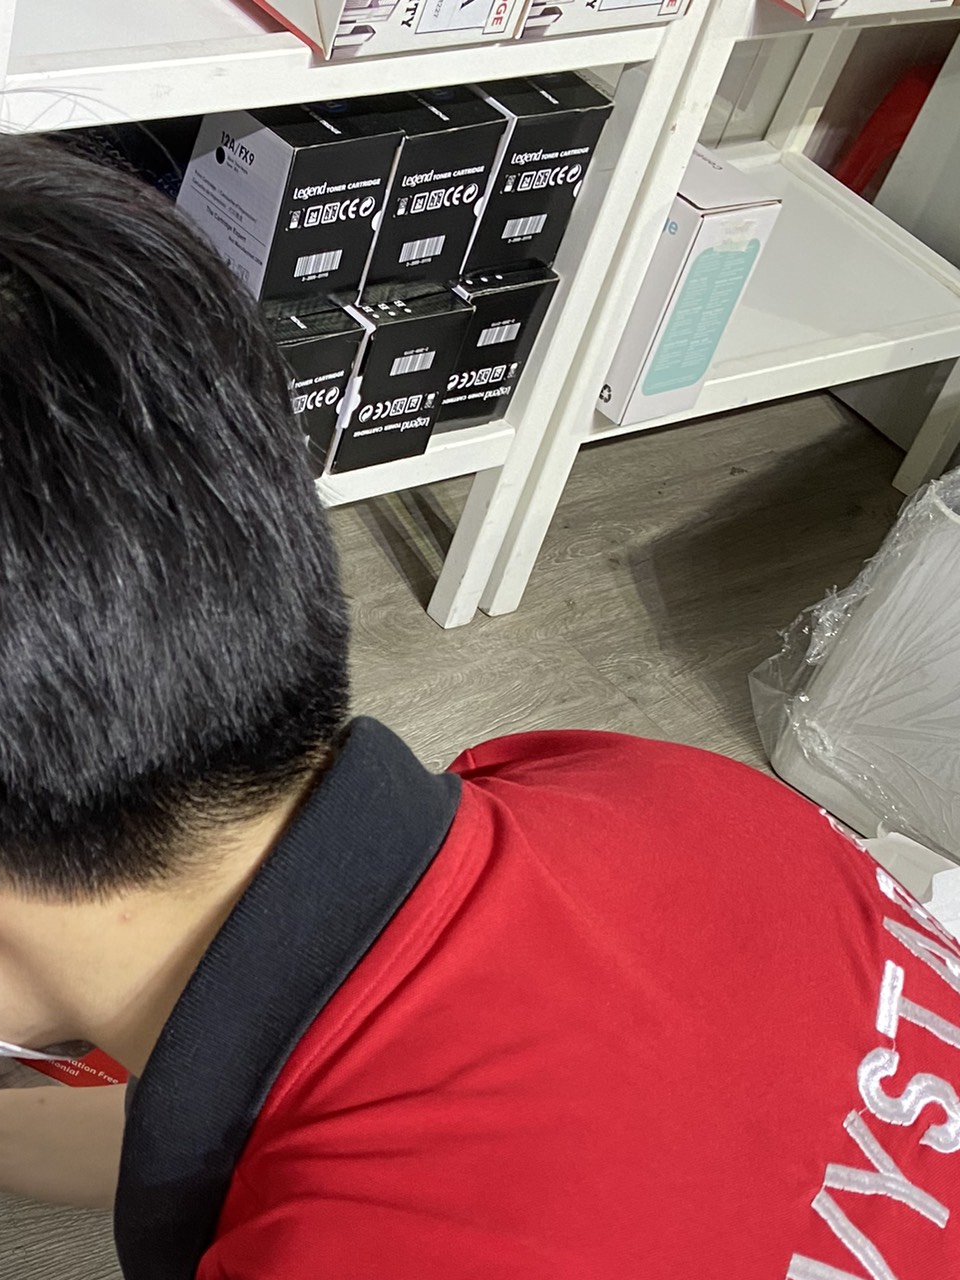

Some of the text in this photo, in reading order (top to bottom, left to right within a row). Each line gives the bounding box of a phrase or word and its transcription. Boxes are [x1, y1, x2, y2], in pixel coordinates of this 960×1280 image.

[401, 0, 418, 28] TY
[492, 0, 508, 27] GE
[220, 131, 256, 167] 12A/FX9
[511, 147, 590, 166] Legend TONER CARTRIDGE
[401, 165, 485, 187] Legend TONER CARTRIDGE
[293, 178, 382, 200] Legend TONER CARTRIDGE
[294, 370, 345, 389] TONER CARTRIDGE
[400, 416, 430, 432] Legend
[97, 1070, 119, 1084] Free
